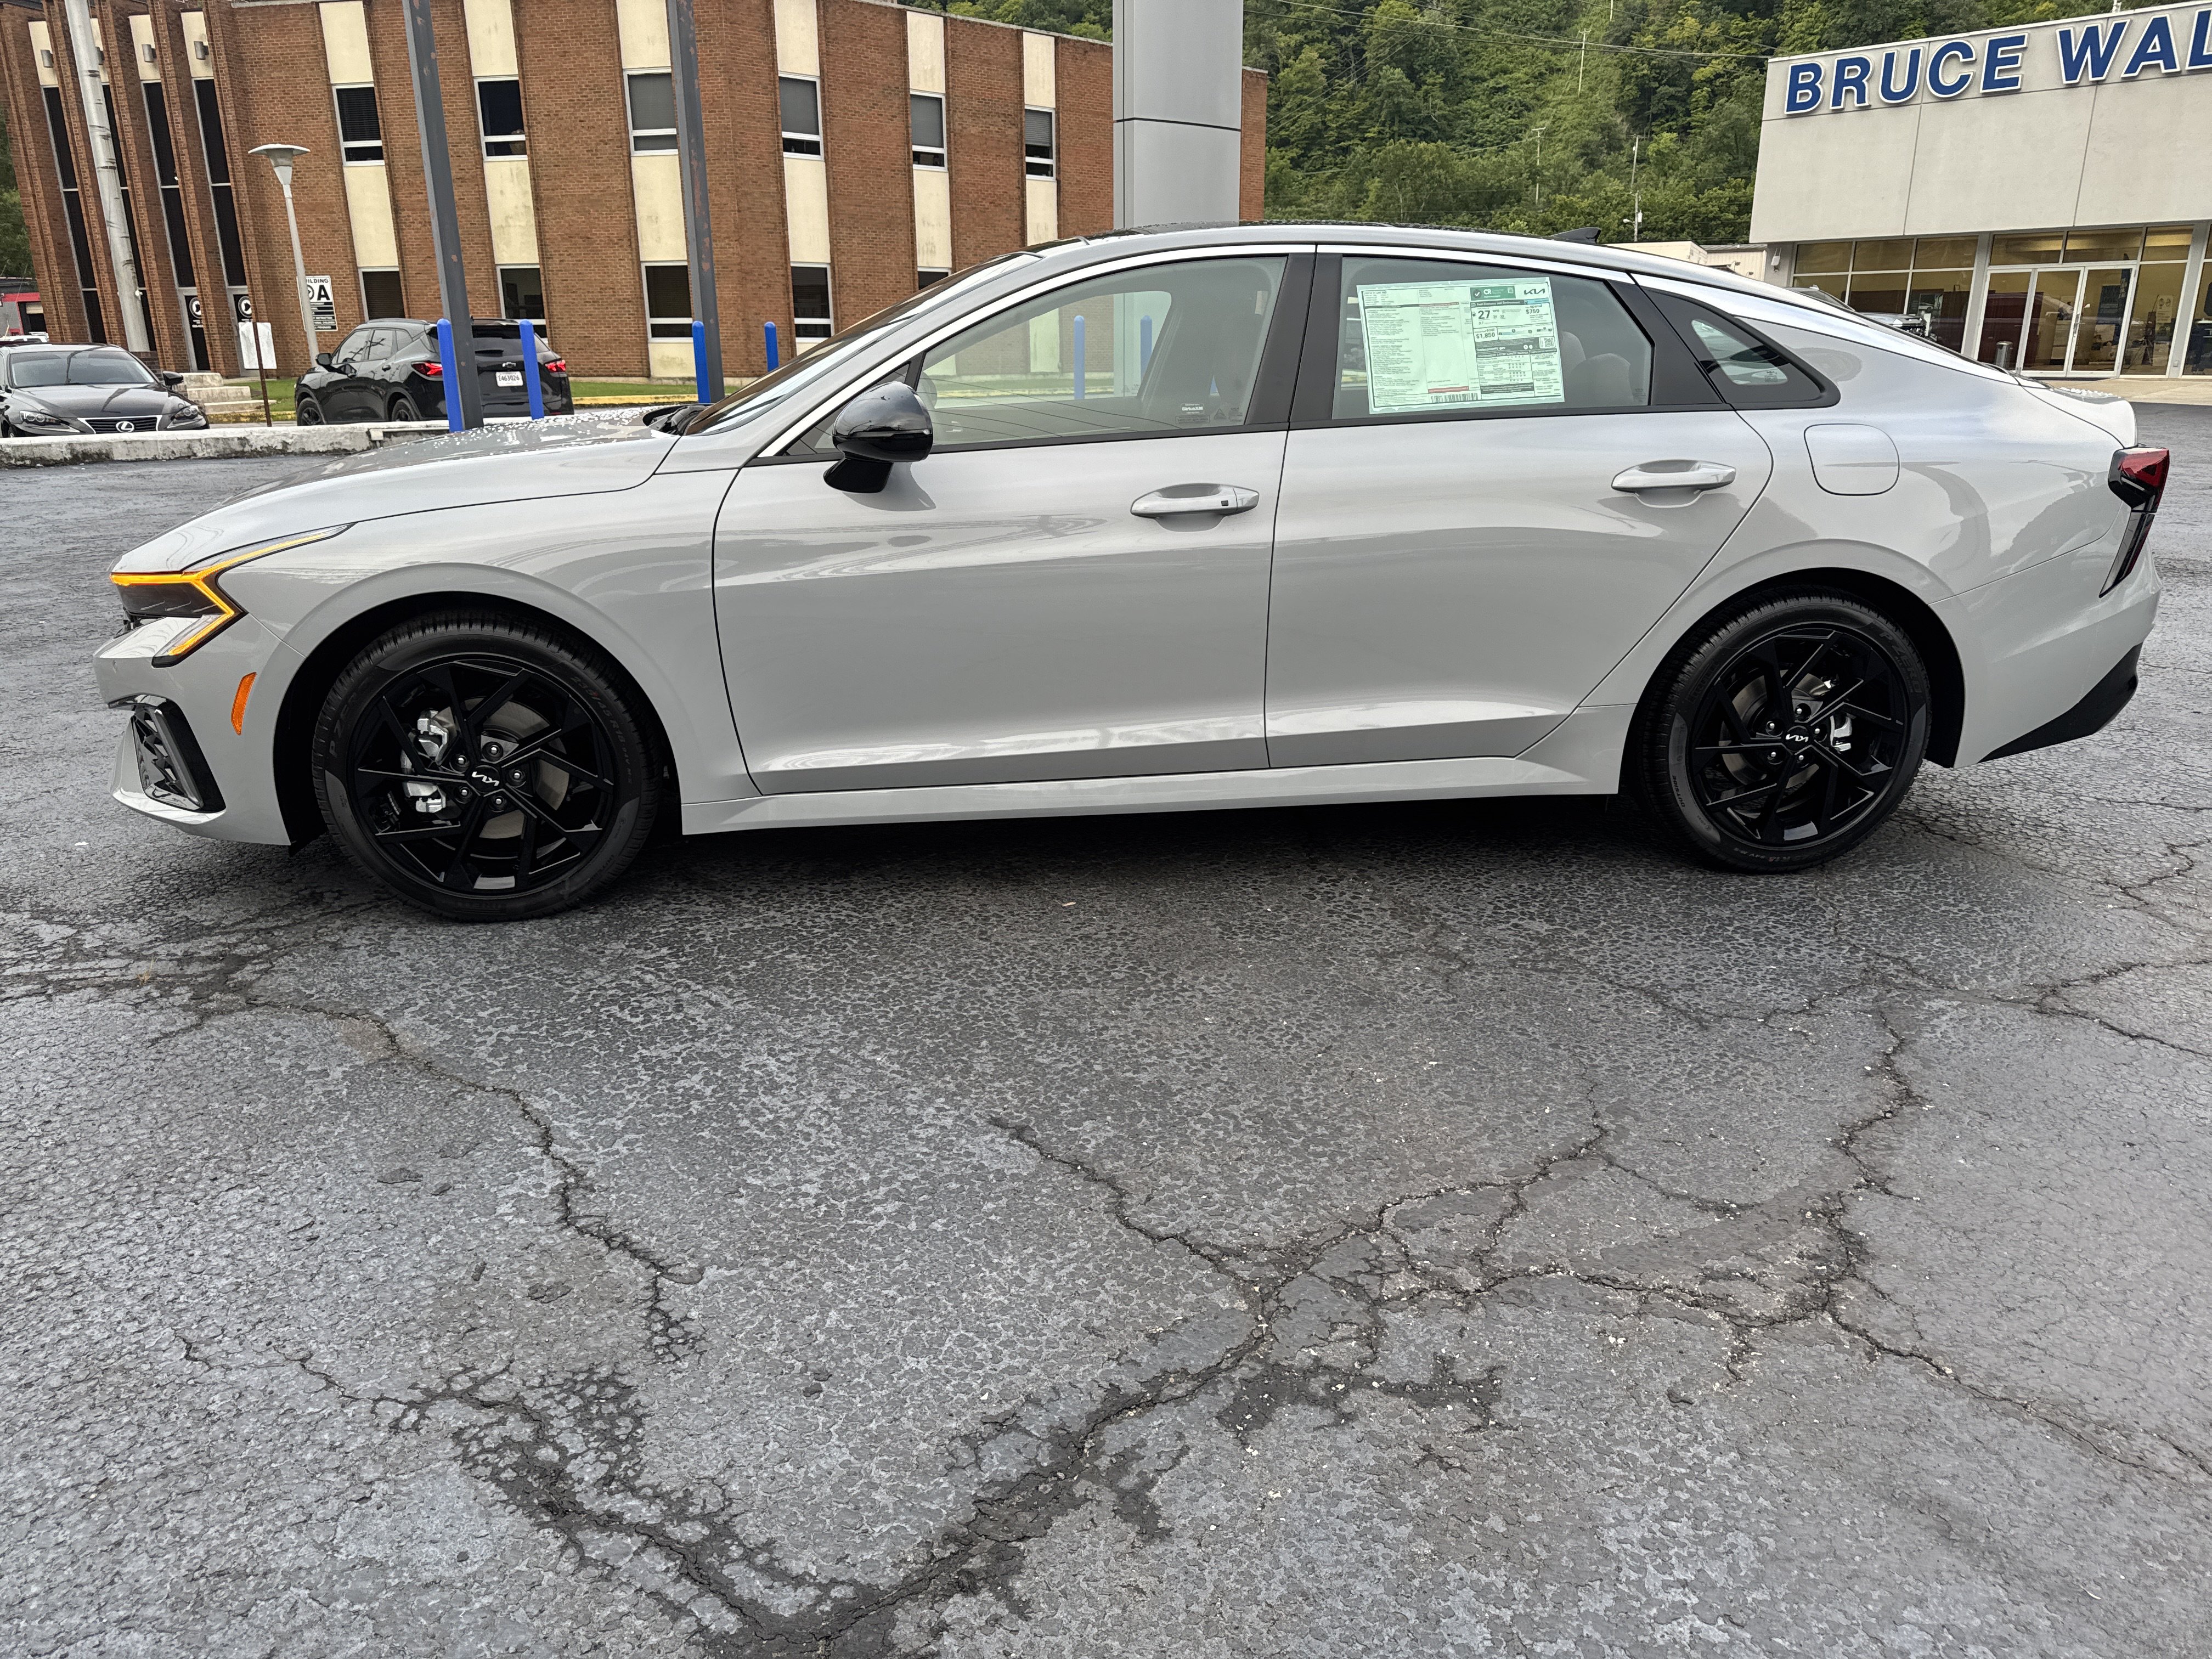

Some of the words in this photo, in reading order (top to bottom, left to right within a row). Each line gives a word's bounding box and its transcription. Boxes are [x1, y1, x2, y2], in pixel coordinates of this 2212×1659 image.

[1784, 32, 2028, 115] BRUCE
[317, 284, 330, 301] A
[1478, 310, 1491, 319] 27
